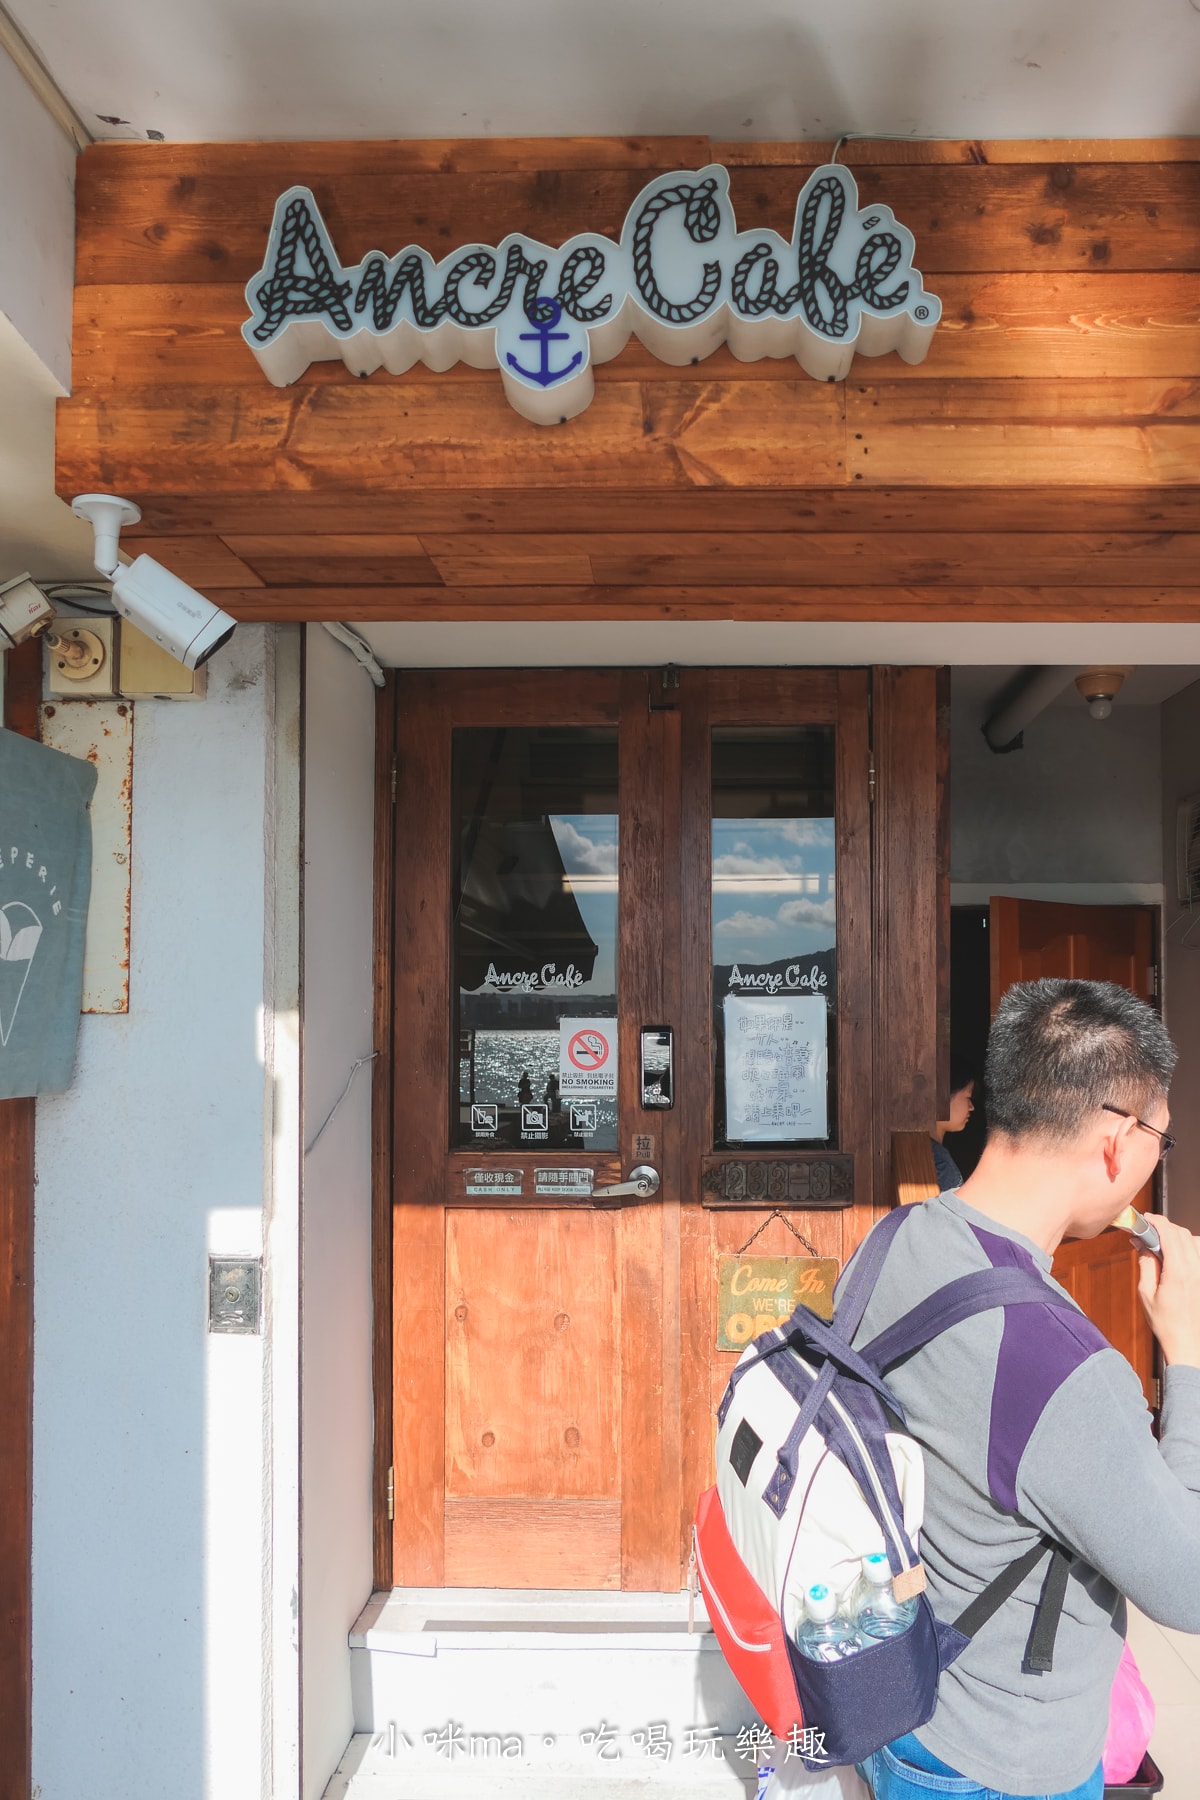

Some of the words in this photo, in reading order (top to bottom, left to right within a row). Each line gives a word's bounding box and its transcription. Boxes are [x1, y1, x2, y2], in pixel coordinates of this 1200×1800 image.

[253, 198, 613, 341] Ancre
[631, 175, 912, 337] Café
[484, 962, 539, 986] Ancre
[728, 964, 783, 988] Ancre
[785, 964, 828, 991] Café
[576, 1078, 614, 1086] SMOKING
[636, 1136, 651, 1151] 拉
[474, 1172, 515, 1183] 僅收現金
[731, 1264, 788, 1296] Come
[793, 1267, 827, 1295] In
[752, 1298, 796, 1312] WE'RE
[725, 1312, 792, 1344] OP
